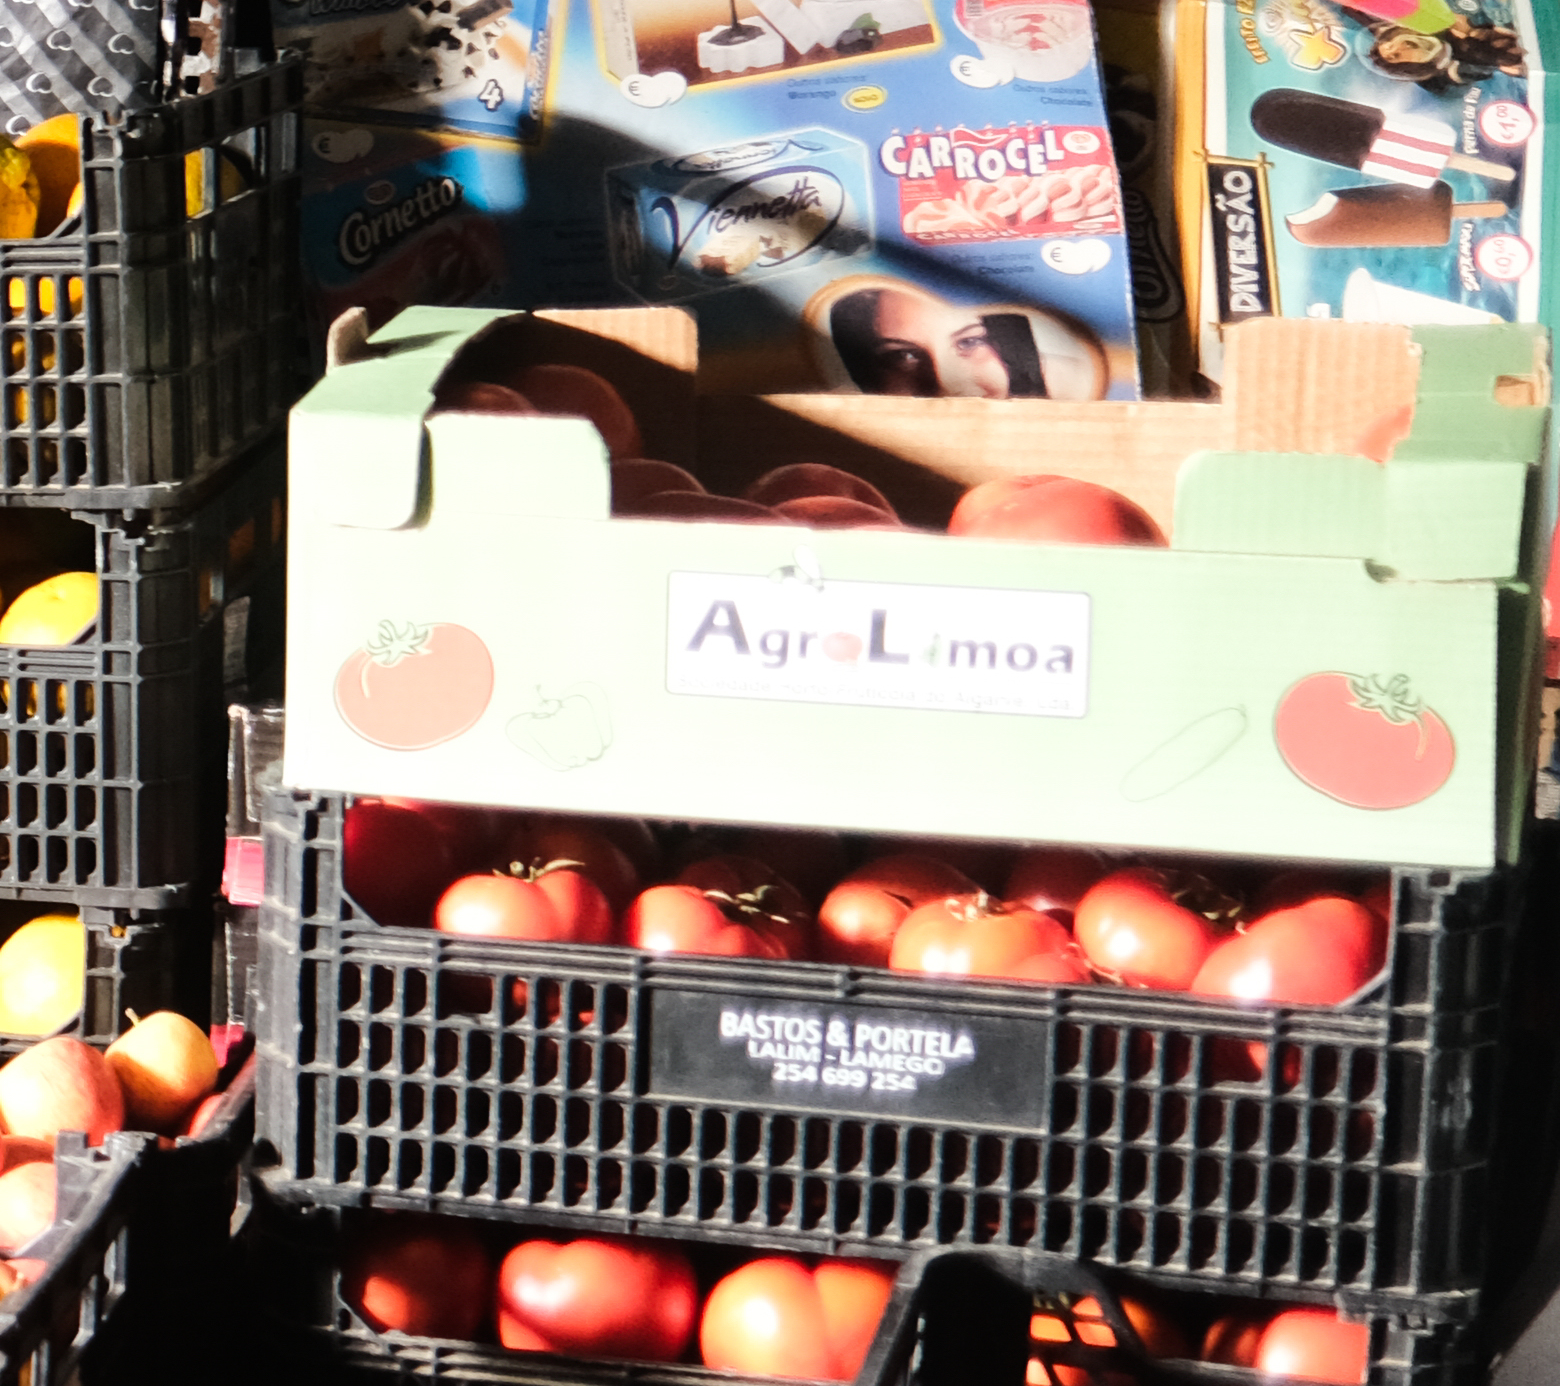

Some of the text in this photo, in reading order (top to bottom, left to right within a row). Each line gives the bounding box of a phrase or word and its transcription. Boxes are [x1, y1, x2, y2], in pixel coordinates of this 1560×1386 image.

[479, 78, 504, 111] 4
[881, 130, 1065, 182] CARROCEL
[339, 178, 456, 265] Cornetto
[1215, 170, 1260, 313] DIVERSÃO
[721, 1011, 976, 1060] BASTOS & PORTELA
[747, 1039, 821, 1062] LALIM
[839, 1047, 946, 1076] LAMEGO
[772, 1062, 919, 1092] 254 699 254
